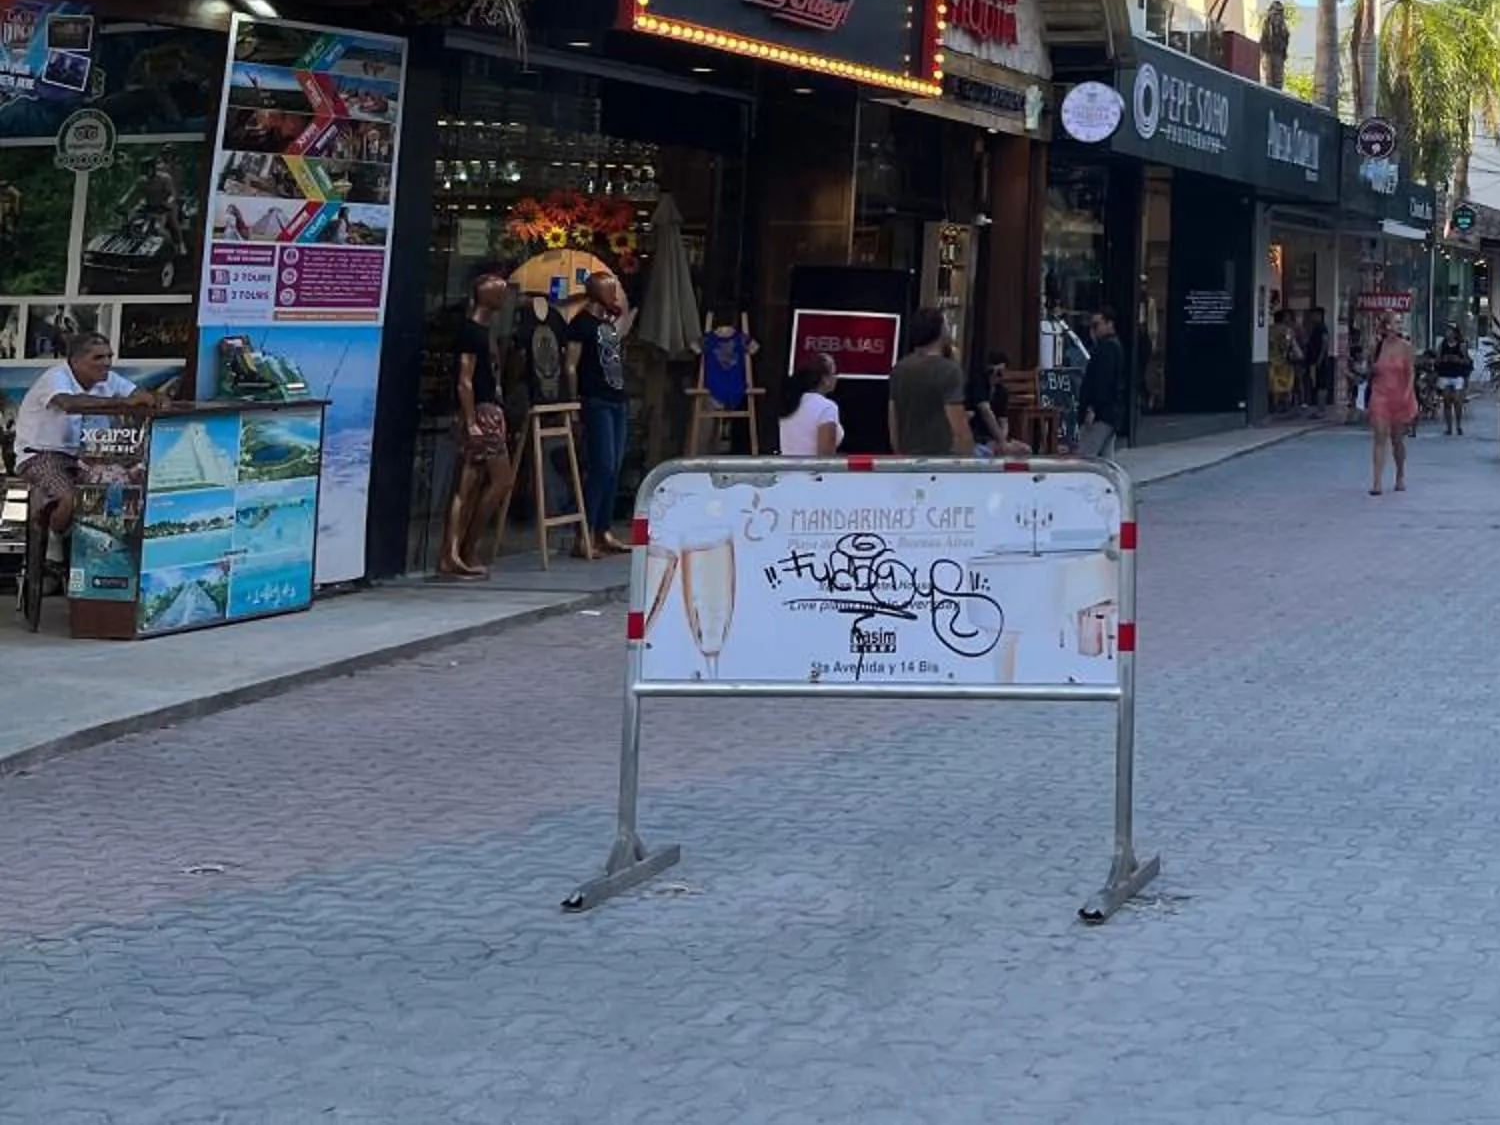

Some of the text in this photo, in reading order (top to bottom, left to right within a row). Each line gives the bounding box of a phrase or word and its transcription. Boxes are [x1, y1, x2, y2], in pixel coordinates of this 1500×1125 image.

[1161, 74, 1229, 137] PEPE SOHO
[1358, 295, 1411, 309] PHARMACY
[804, 335, 886, 354] REBAJAS
[926, 506, 976, 529] CAFE
[833, 661, 884, 673] Avenida
[888, 663, 896, 674] y
[901, 661, 915, 673] 14
[919, 661, 939, 673] Bis
